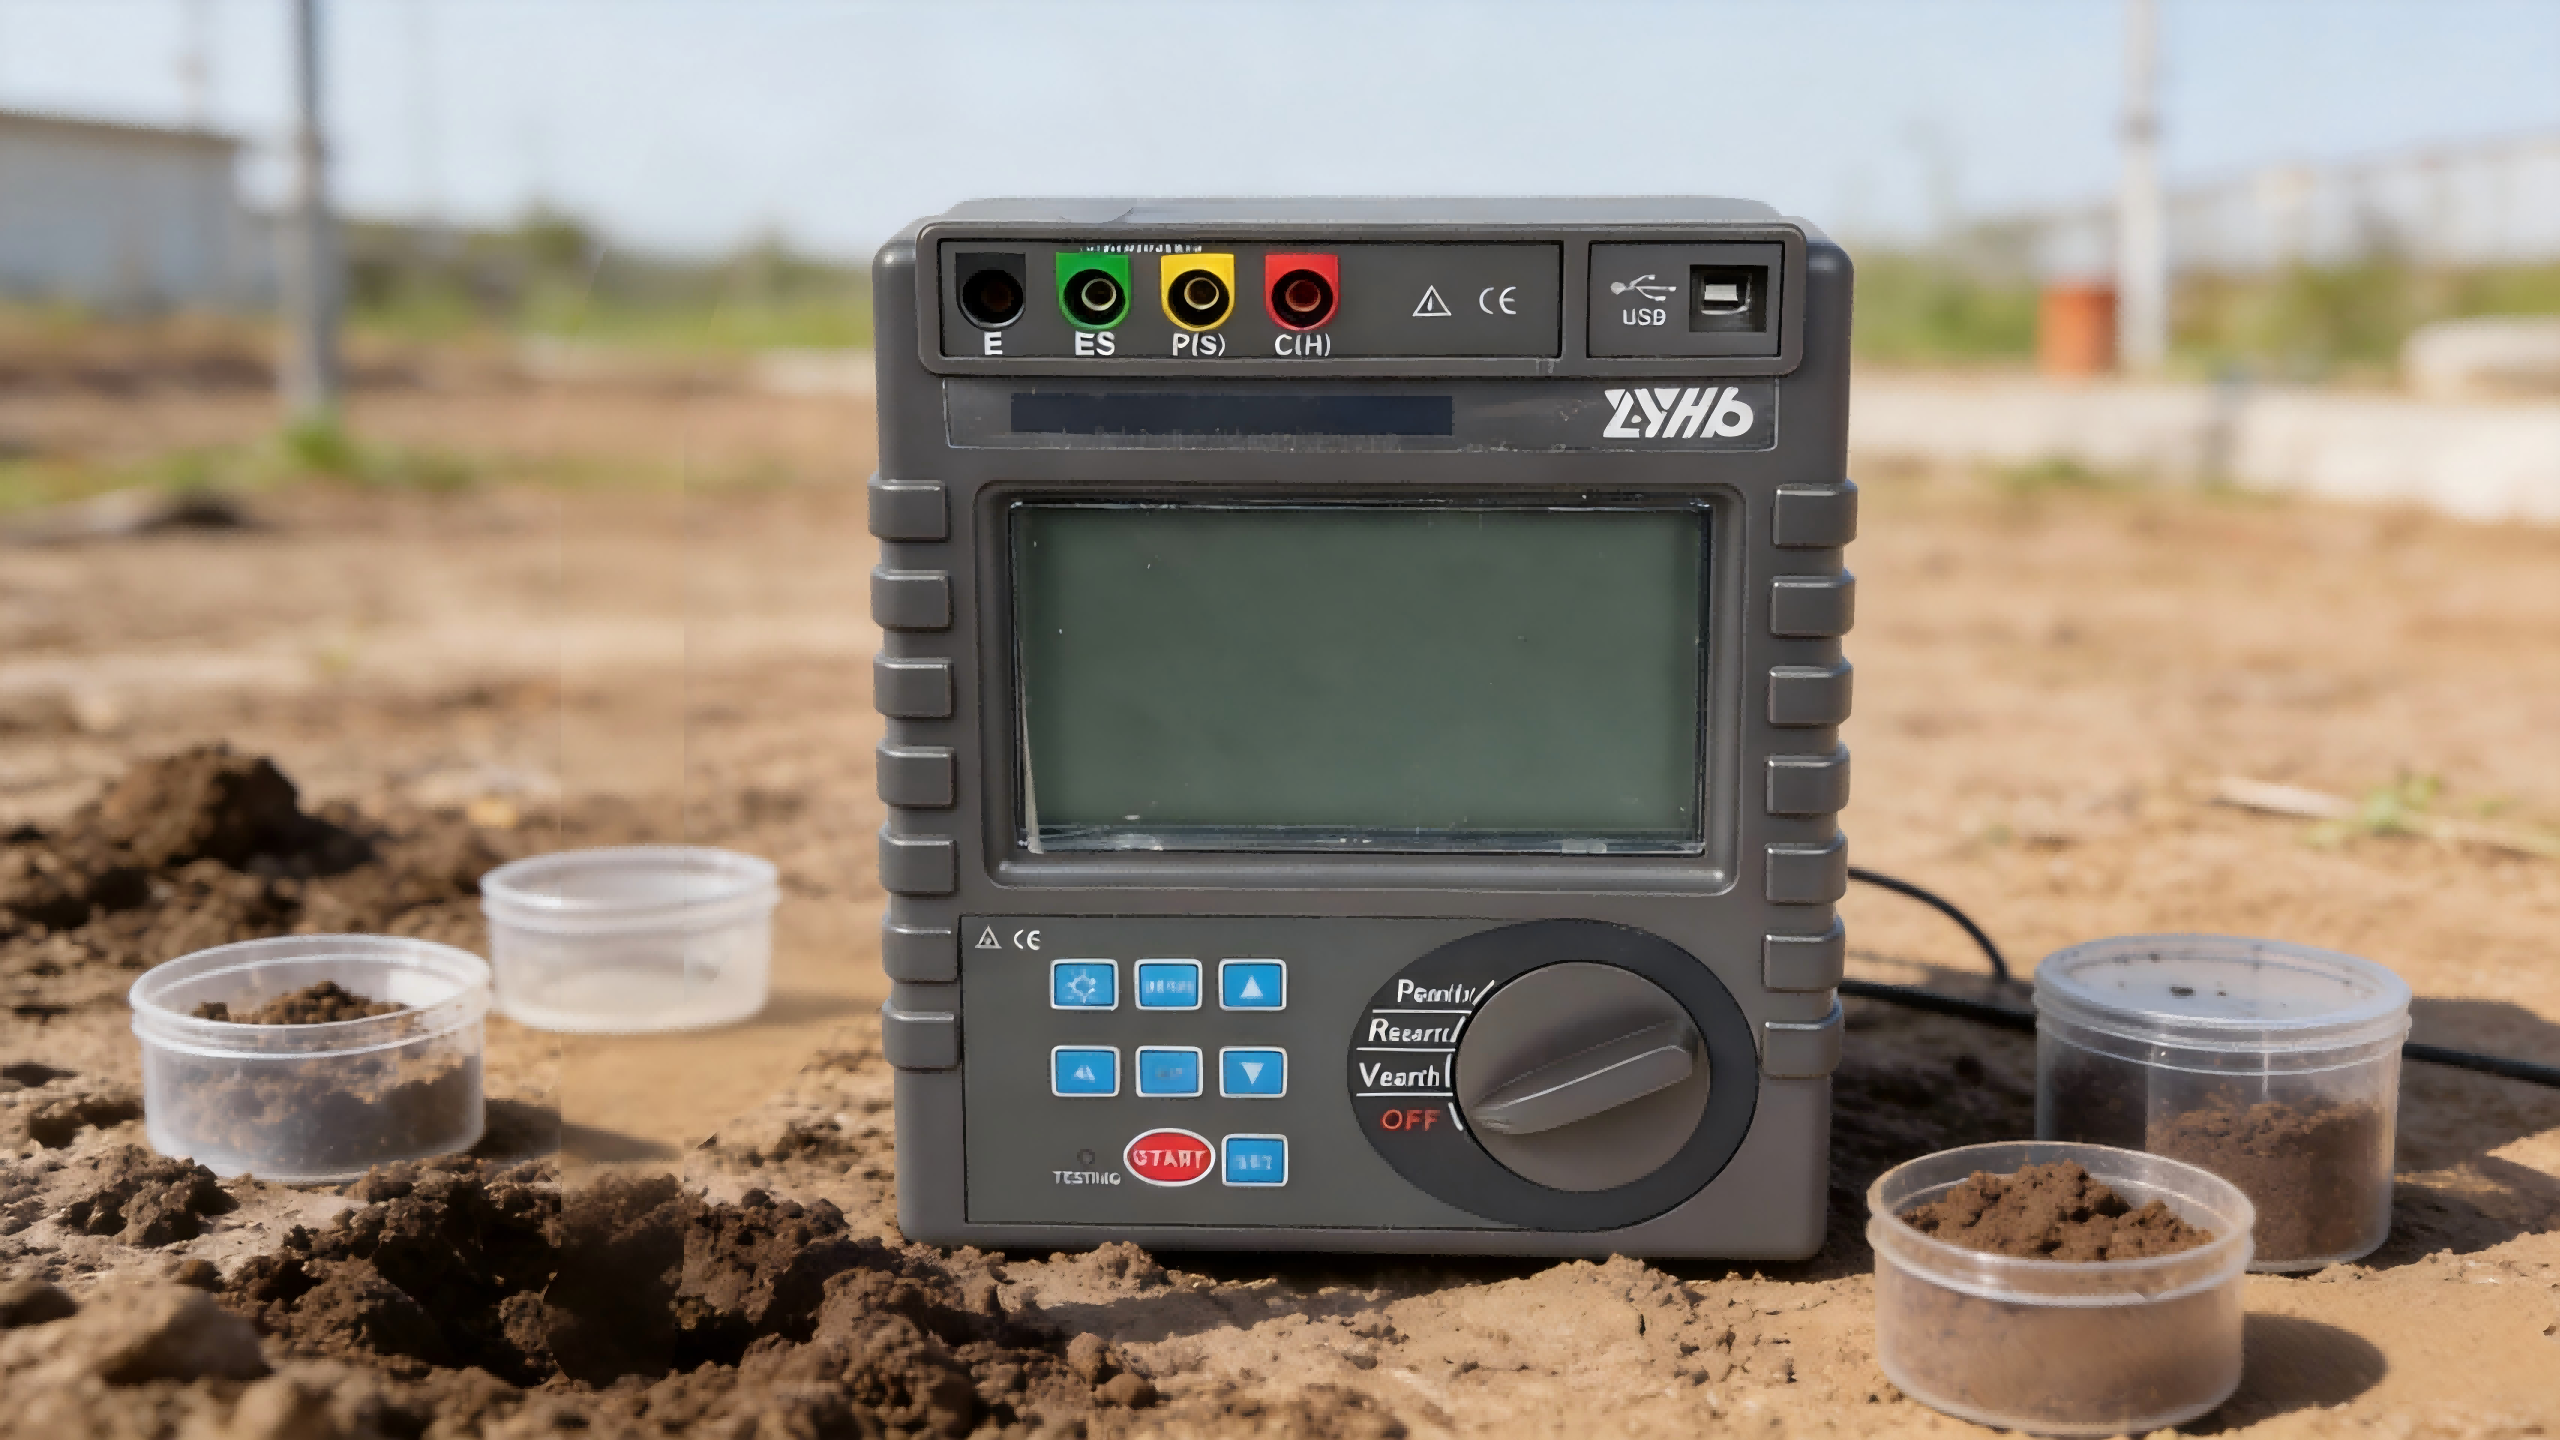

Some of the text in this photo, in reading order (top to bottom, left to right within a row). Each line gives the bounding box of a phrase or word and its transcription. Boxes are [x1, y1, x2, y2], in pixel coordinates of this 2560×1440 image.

[1622, 308, 1667, 326] USB
[983, 331, 1003, 356] E
[1074, 330, 1115, 356] ES
[1172, 332, 1226, 357] P(S)
[1274, 333, 1331, 357] C(H)
[1382, 1109, 1441, 1132] OFF
